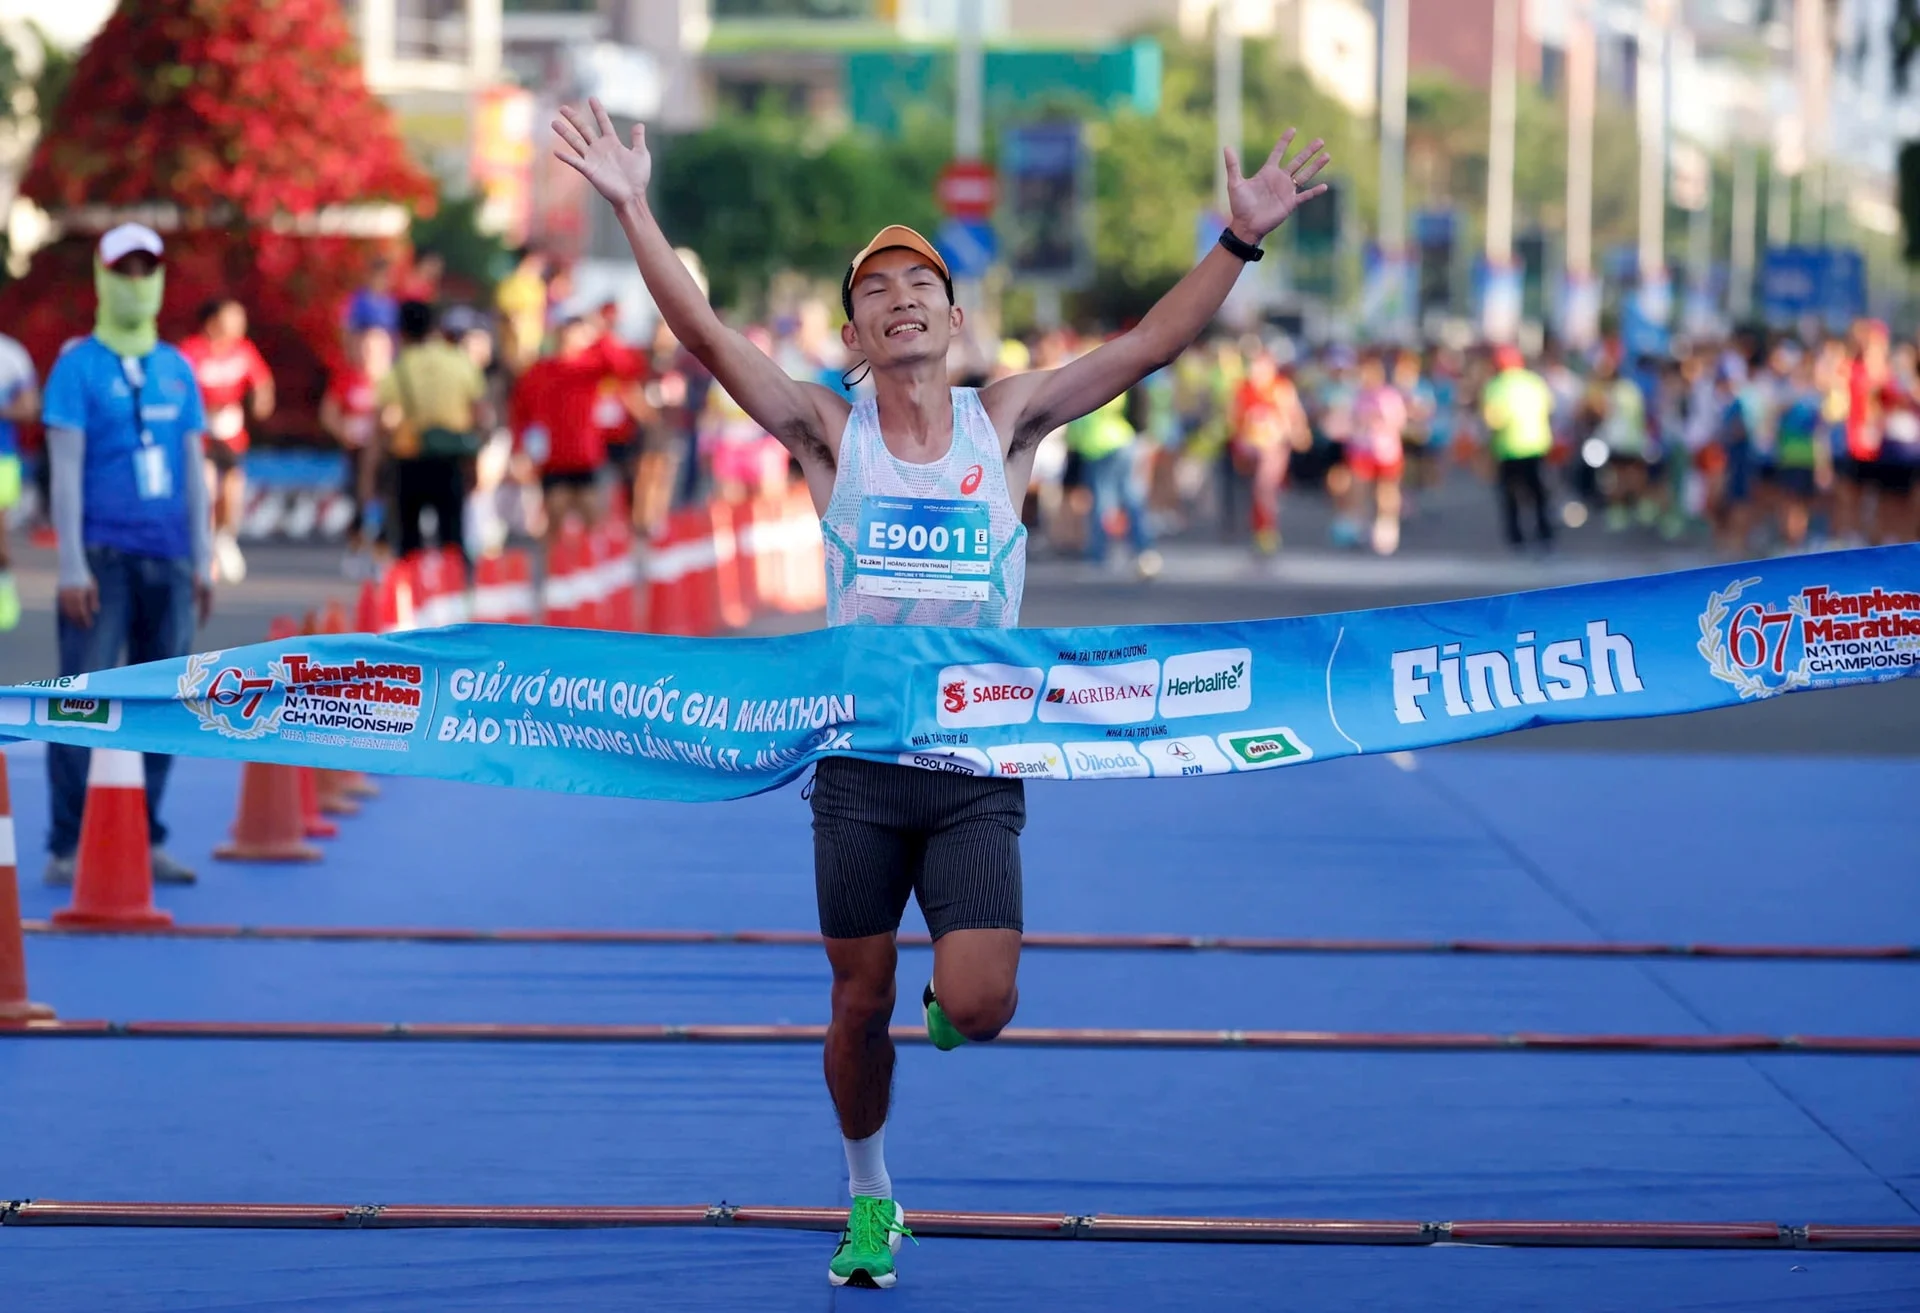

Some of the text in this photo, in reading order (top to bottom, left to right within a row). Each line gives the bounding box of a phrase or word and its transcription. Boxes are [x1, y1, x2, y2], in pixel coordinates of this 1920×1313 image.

[868, 521, 966, 553] E9001
[979, 533, 985, 542] E
[1728, 604, 1793, 674] 67
[1803, 614, 1920, 644] Maratho
[1108, 648, 1122, 659] KIM
[1806, 640, 1895, 658] NATIONAL
[1391, 619, 1645, 724] Finish
[1810, 654, 1920, 672] CHAMPIONSH
[208, 668, 273, 717] 67
[973, 685, 1034, 703] SABECO
[1066, 684, 1156, 705] AGRIBANK
[1166, 672, 1240, 697] Herbalife
[63, 697, 96, 711] MILO
[285, 696, 373, 716] NATIONAL
[450, 661, 512, 702] GIẢI
[549, 676, 607, 717] ĐỊCH
[610, 675, 681, 723] QUỐC
[682, 692, 729, 730] GIA
[733, 695, 856, 733] MARATHON
[283, 710, 414, 733] CHAMPIONSHIP
[504, 708, 559, 747] TIỀN
[558, 723, 634, 756] PHONG
[633, 722, 679, 761] LẦN
[717, 747, 741, 772] 67
[912, 732, 930, 747] NHÀ
[958, 732, 969, 745] ÁO
[1249, 744, 1279, 755] MILO
[1000, 760, 1049, 775] HDBank
[1182, 764, 1204, 776] EVN
